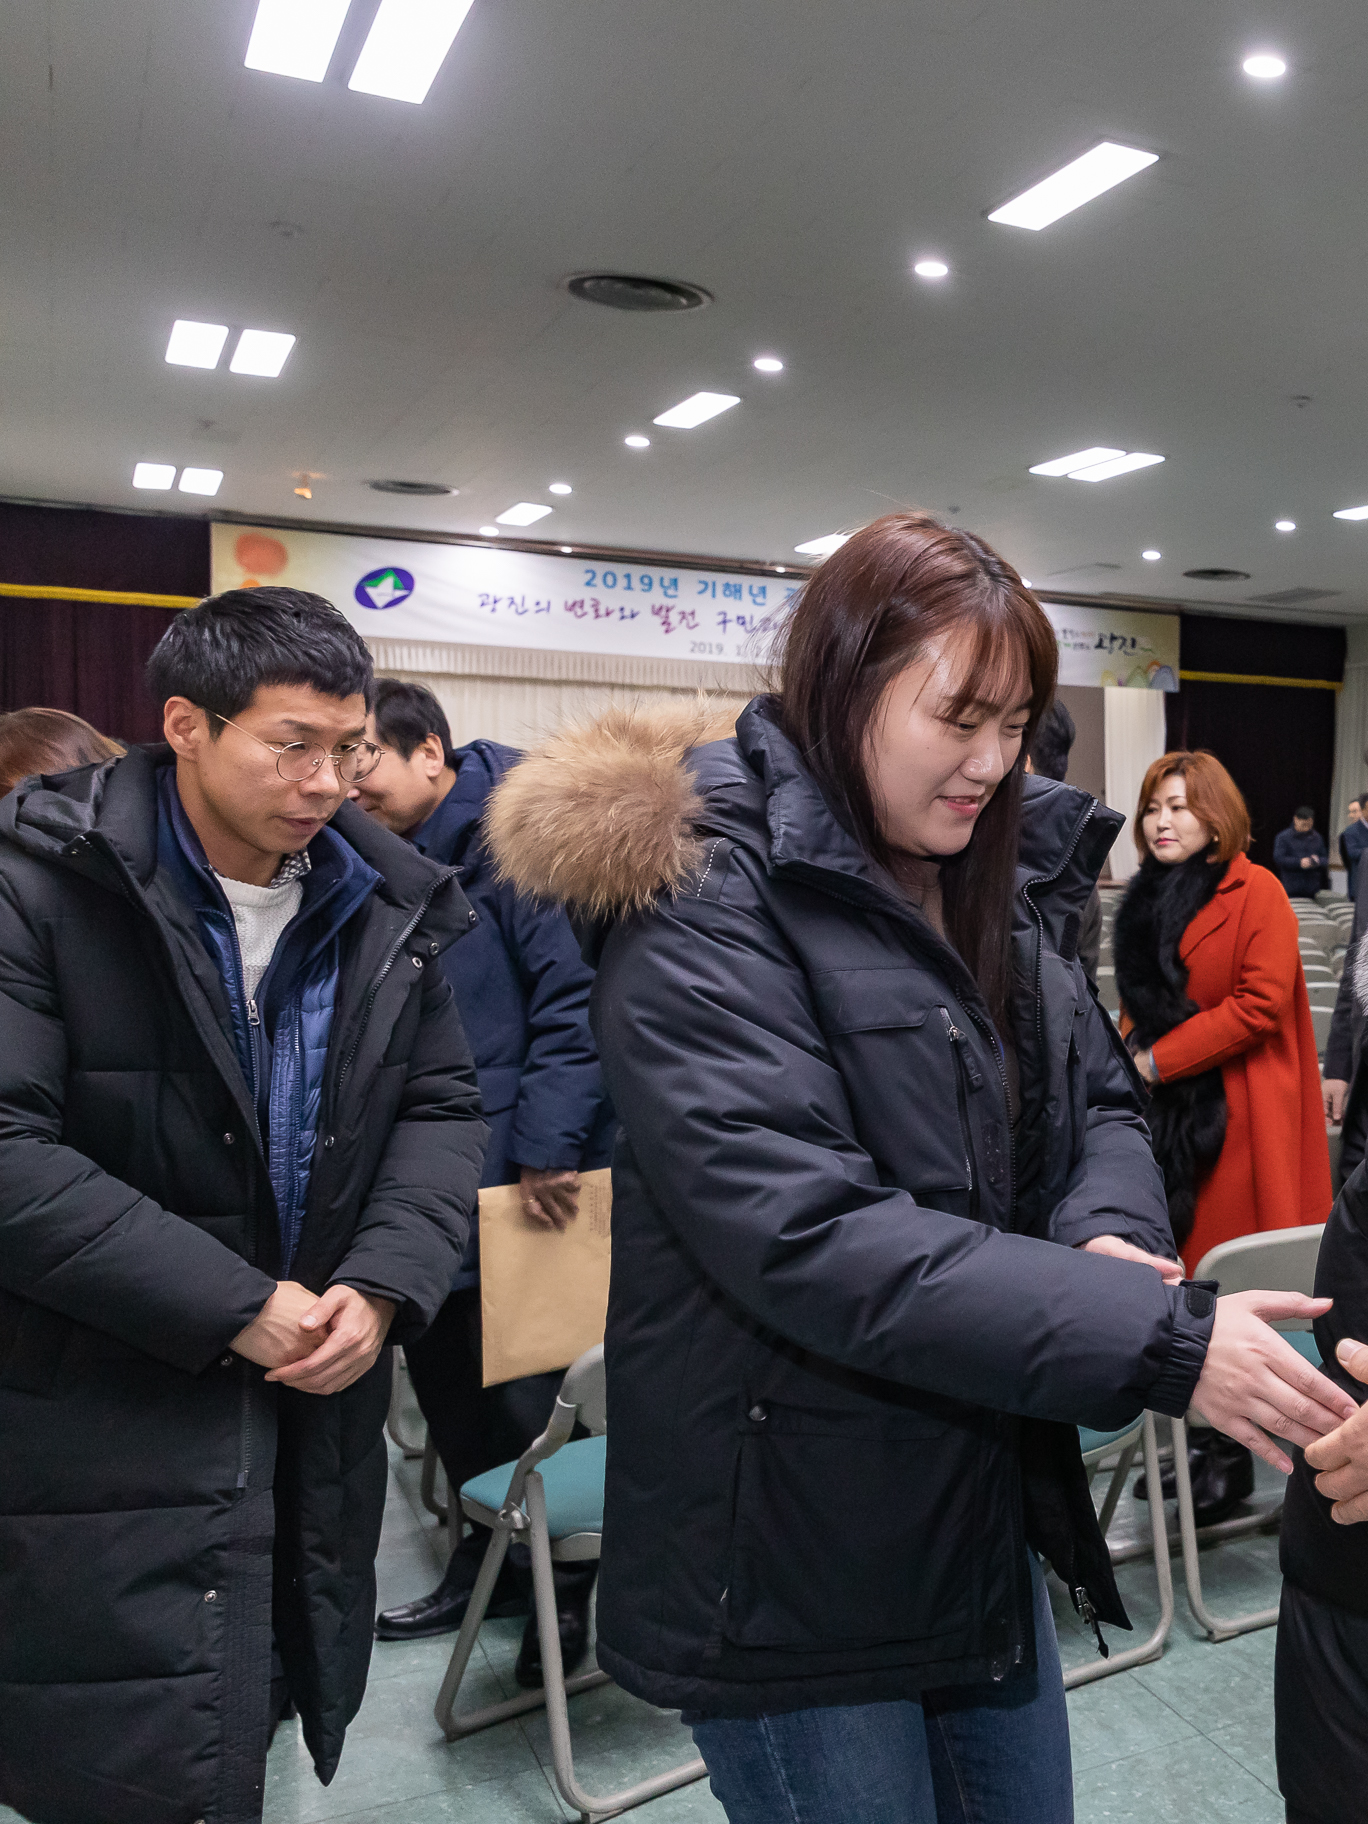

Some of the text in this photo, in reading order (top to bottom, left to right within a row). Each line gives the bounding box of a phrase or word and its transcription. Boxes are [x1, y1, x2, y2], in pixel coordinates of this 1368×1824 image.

[584, 568, 679, 599] 2019년
[697, 579, 768, 606] 기해년
[478, 593, 551, 616] 광진의
[564, 597, 641, 621] 변화와
[651, 603, 700, 635] 발전
